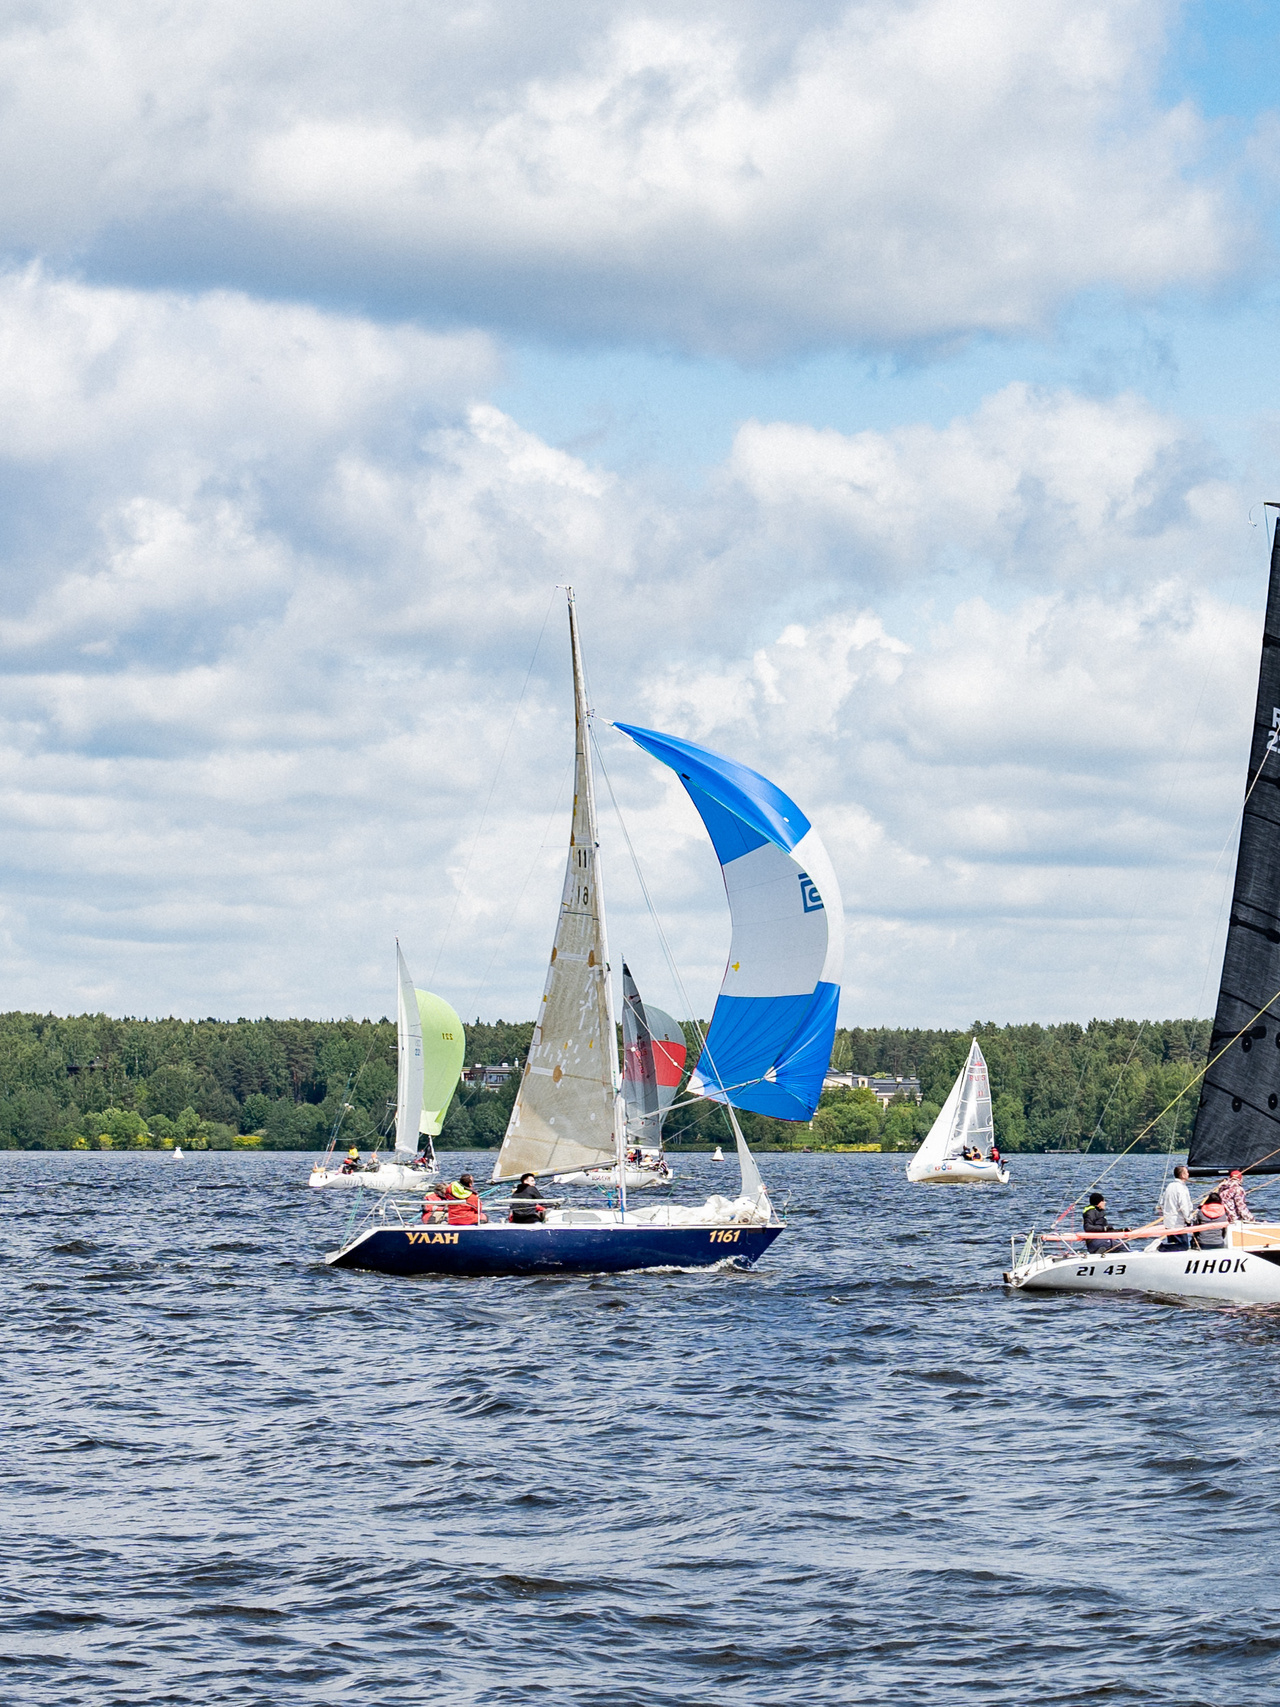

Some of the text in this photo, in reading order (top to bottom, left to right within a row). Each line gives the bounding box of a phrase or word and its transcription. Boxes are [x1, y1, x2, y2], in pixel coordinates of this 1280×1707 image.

[405, 1231, 460, 1245] УЛАН
[709, 1229, 741, 1243] 1161
[1076, 1264, 1127, 1276] 21 43
[1184, 1258, 1249, 1274] ИНОК
